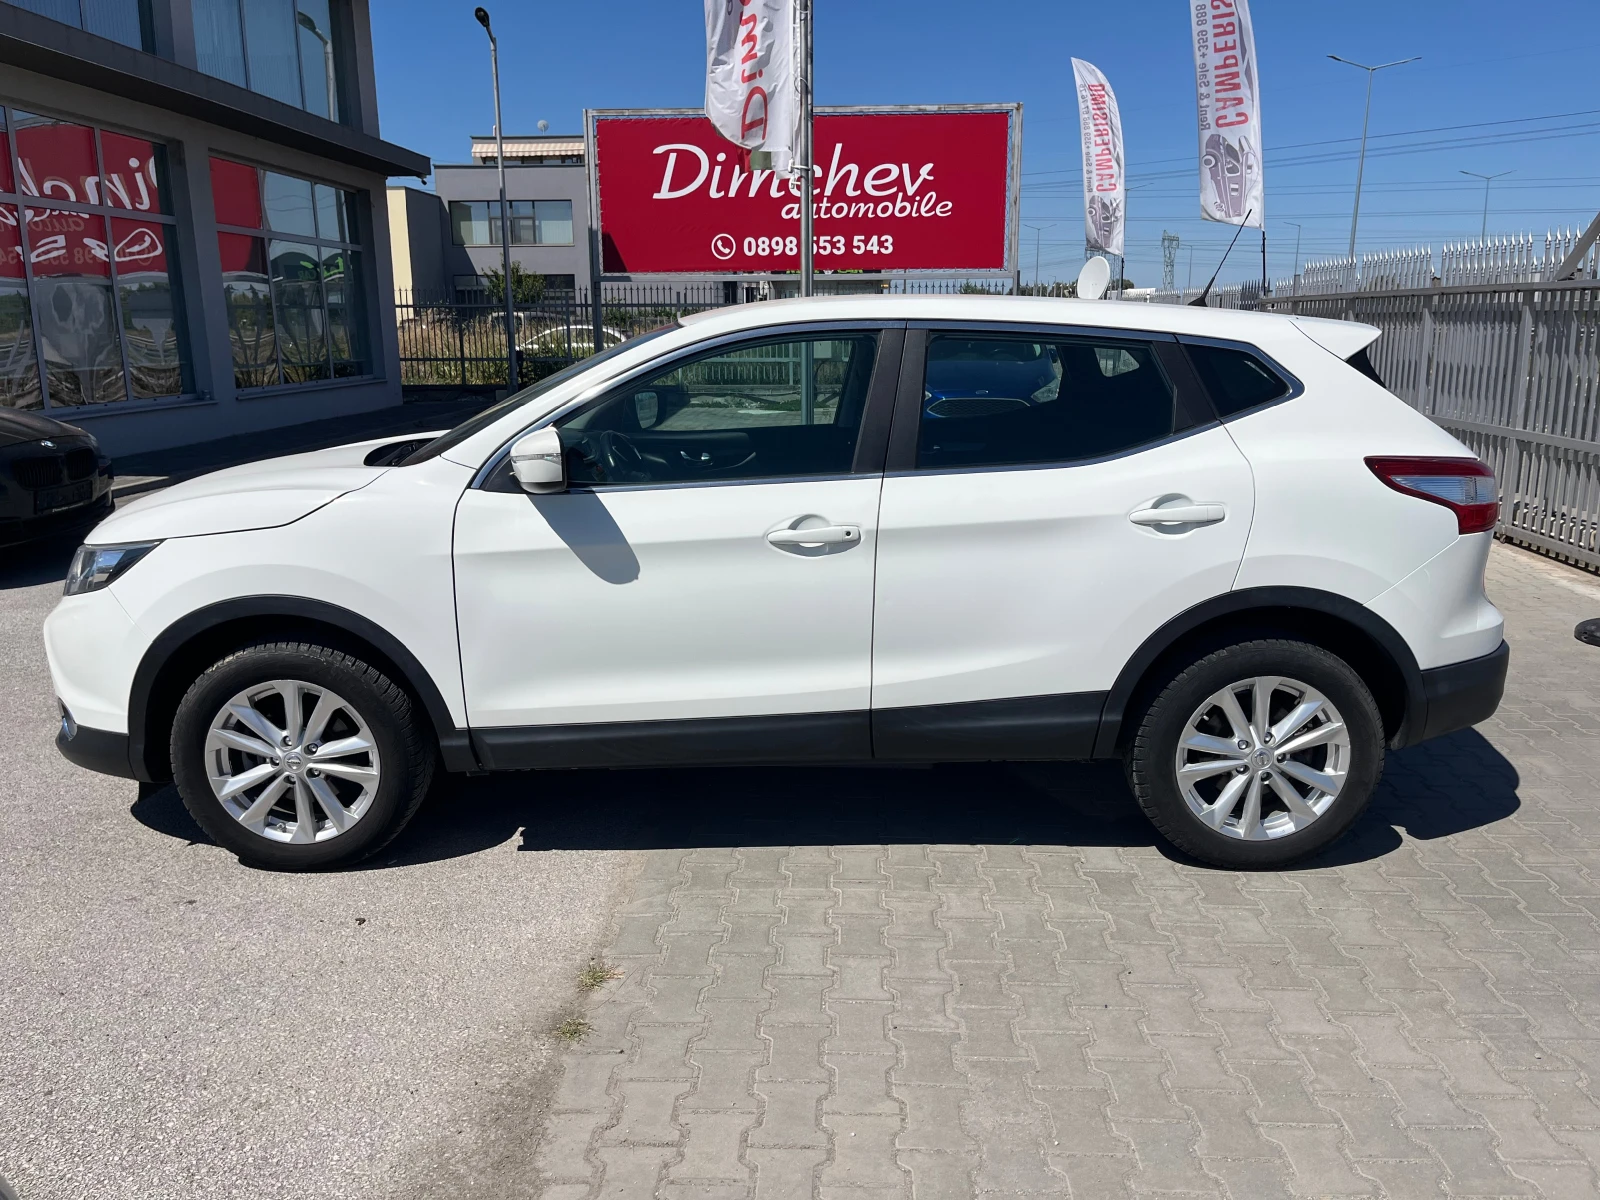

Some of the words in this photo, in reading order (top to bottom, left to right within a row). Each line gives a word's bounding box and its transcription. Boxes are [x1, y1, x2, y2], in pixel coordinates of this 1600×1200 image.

[652, 143, 934, 199] Dimchev
[743, 236, 798, 257] 0898
[852, 235, 894, 255] 543
